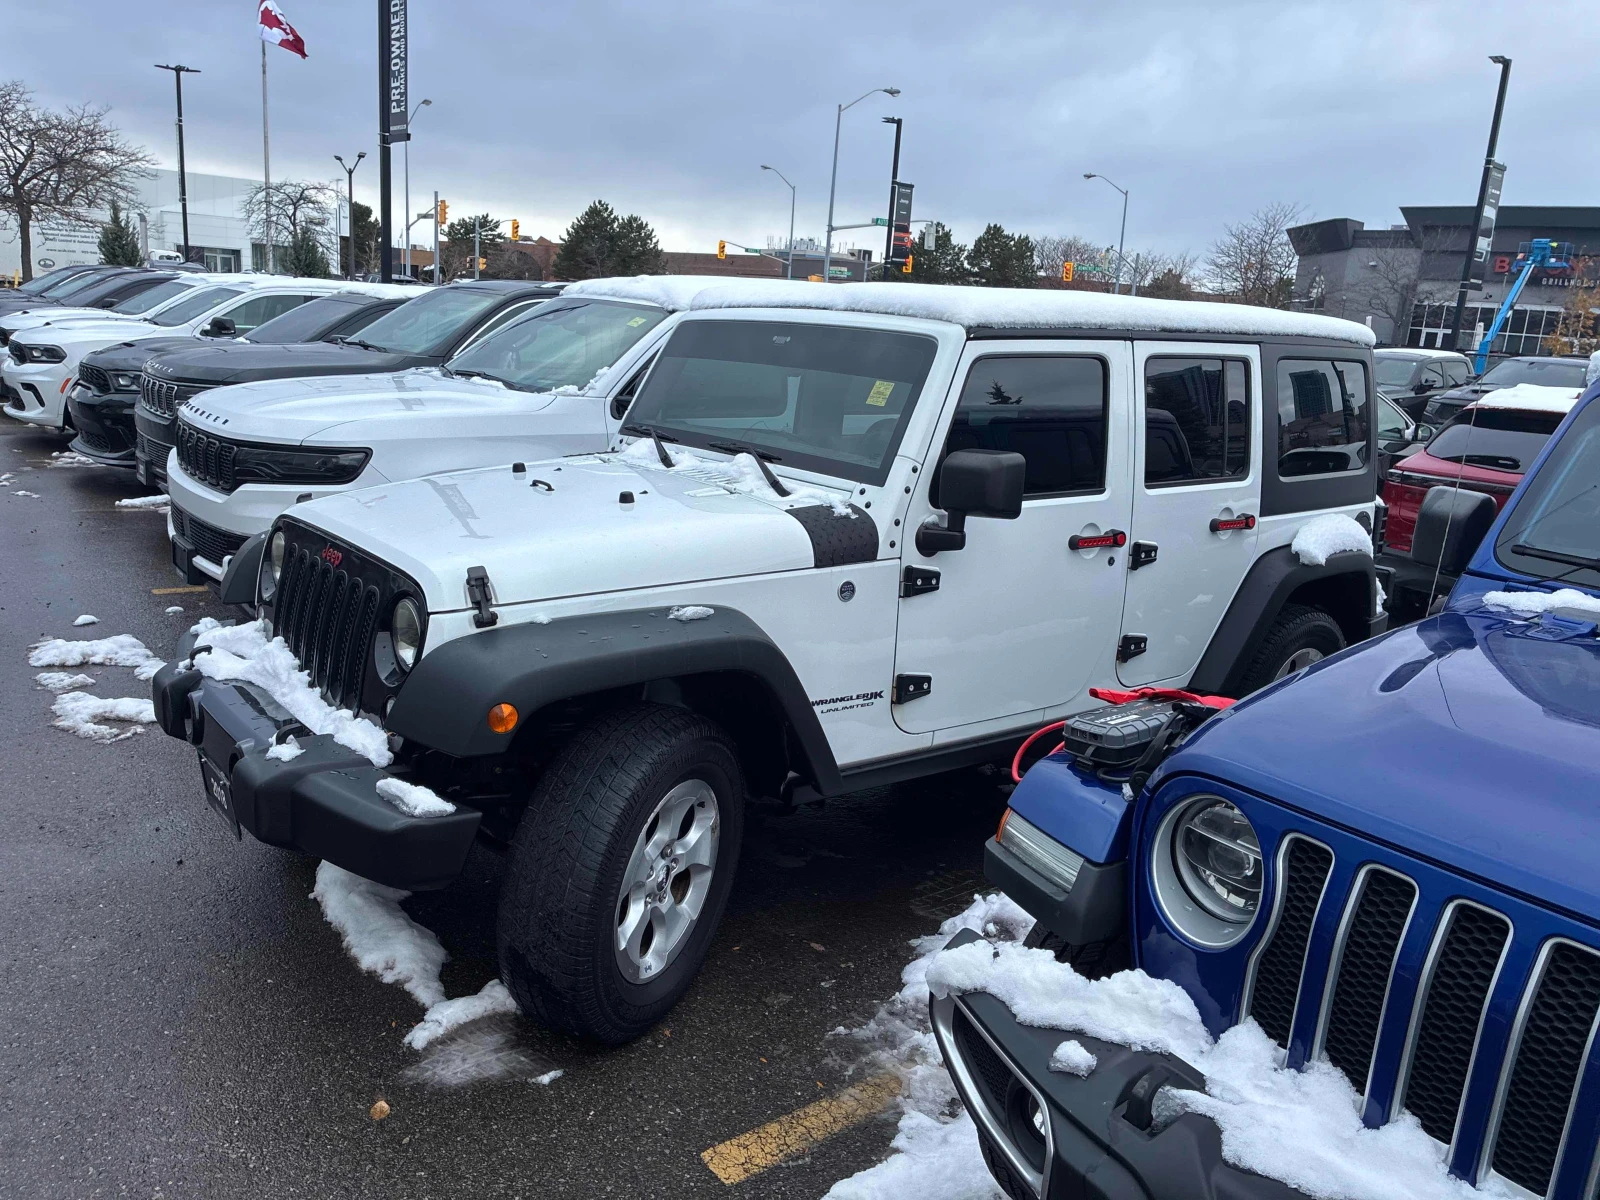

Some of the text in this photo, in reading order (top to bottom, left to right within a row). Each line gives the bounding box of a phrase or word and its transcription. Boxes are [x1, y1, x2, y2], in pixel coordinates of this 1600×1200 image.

[390, 0, 401, 114] PRE-OWNED
[322, 543, 343, 568] Jeep
[820, 701, 875, 714] UNLIMITED
